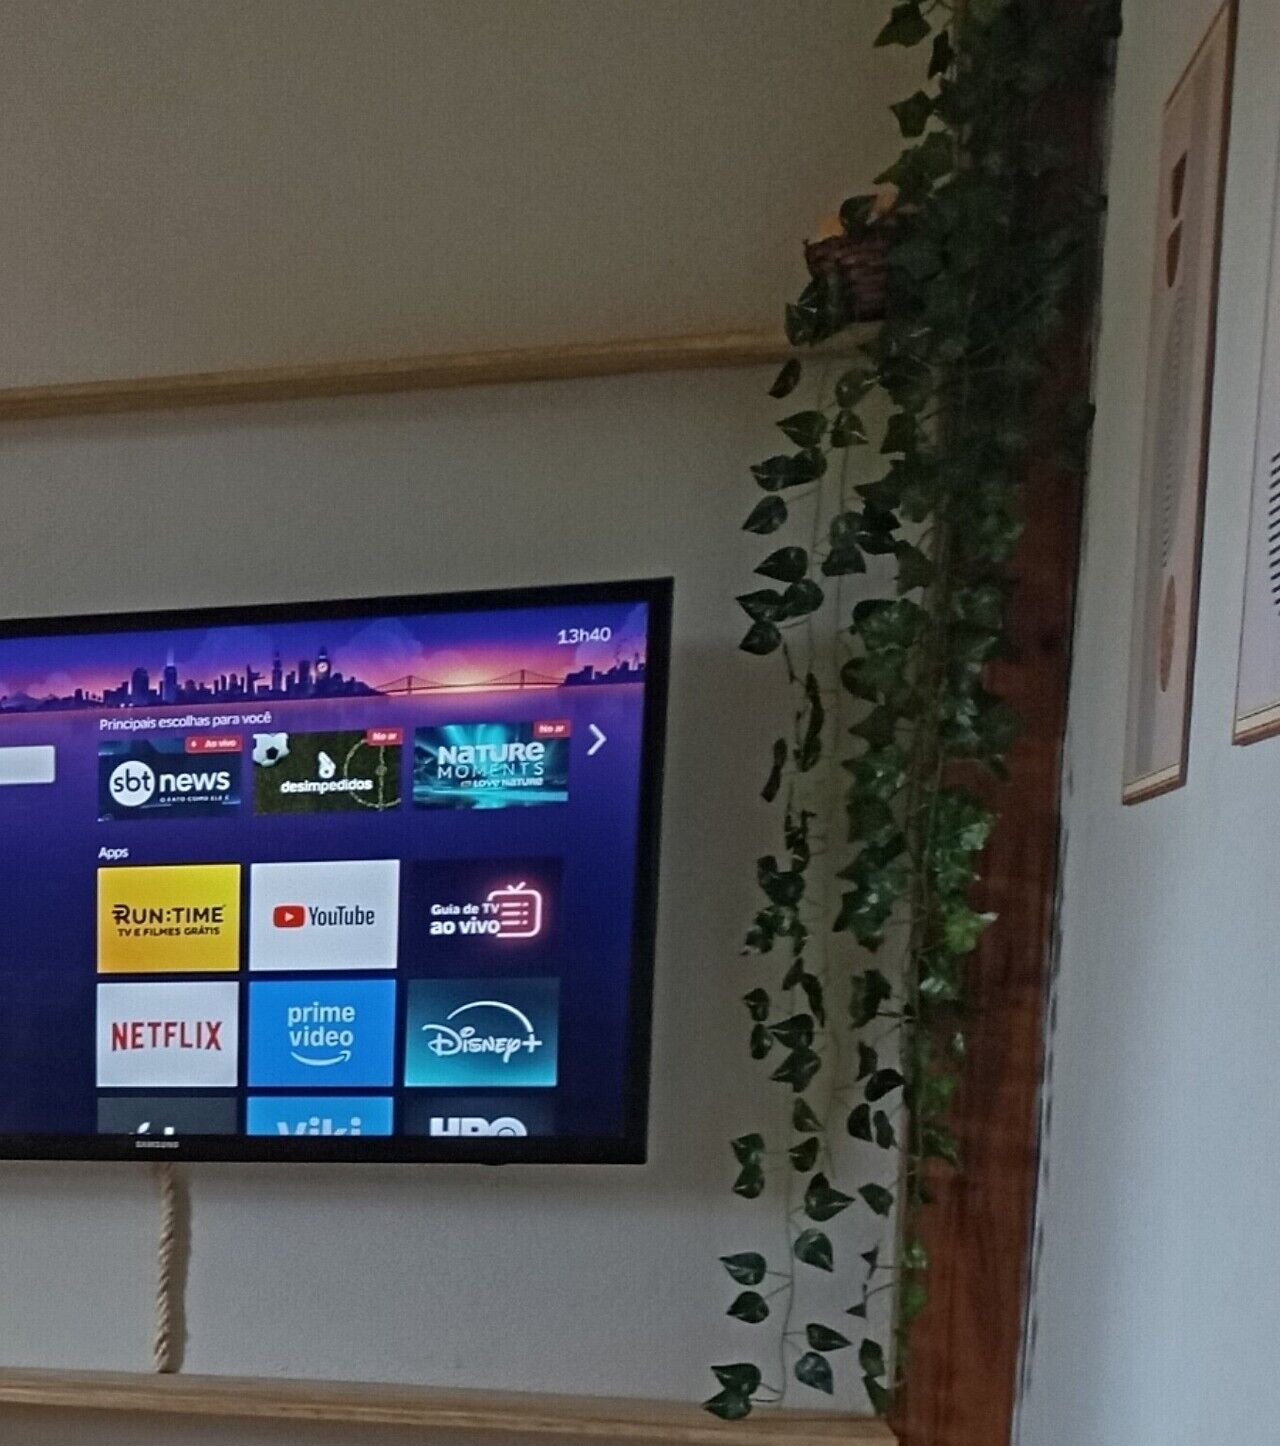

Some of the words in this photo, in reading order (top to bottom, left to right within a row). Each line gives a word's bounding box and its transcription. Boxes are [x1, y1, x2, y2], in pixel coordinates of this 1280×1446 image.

[557, 627, 611, 645] 13h40
[99, 717, 156, 731] Principais
[158, 715, 210, 728] escolhas
[212, 714, 239, 727] para
[242, 711, 272, 724] você
[437, 761, 544, 779] MOMENTS
[113, 768, 151, 793] sbt
[159, 771, 230, 793] news
[281, 778, 373, 794] desimpedidos
[98, 846, 129, 859] Apps
[308, 905, 375, 926] YouTube
[431, 904, 461, 916] Guia
[462, 904, 480, 915] de
[482, 903, 500, 915] TV
[117, 928, 132, 937] TV
[134, 928, 141, 936] E
[143, 926, 181, 936] FILMES
[430, 920, 456, 935] ao
[458, 916, 501, 935] vivo
[288, 1001, 356, 1027] prime
[112, 1021, 223, 1051] NETFLIX
[290, 1027, 354, 1047] video
